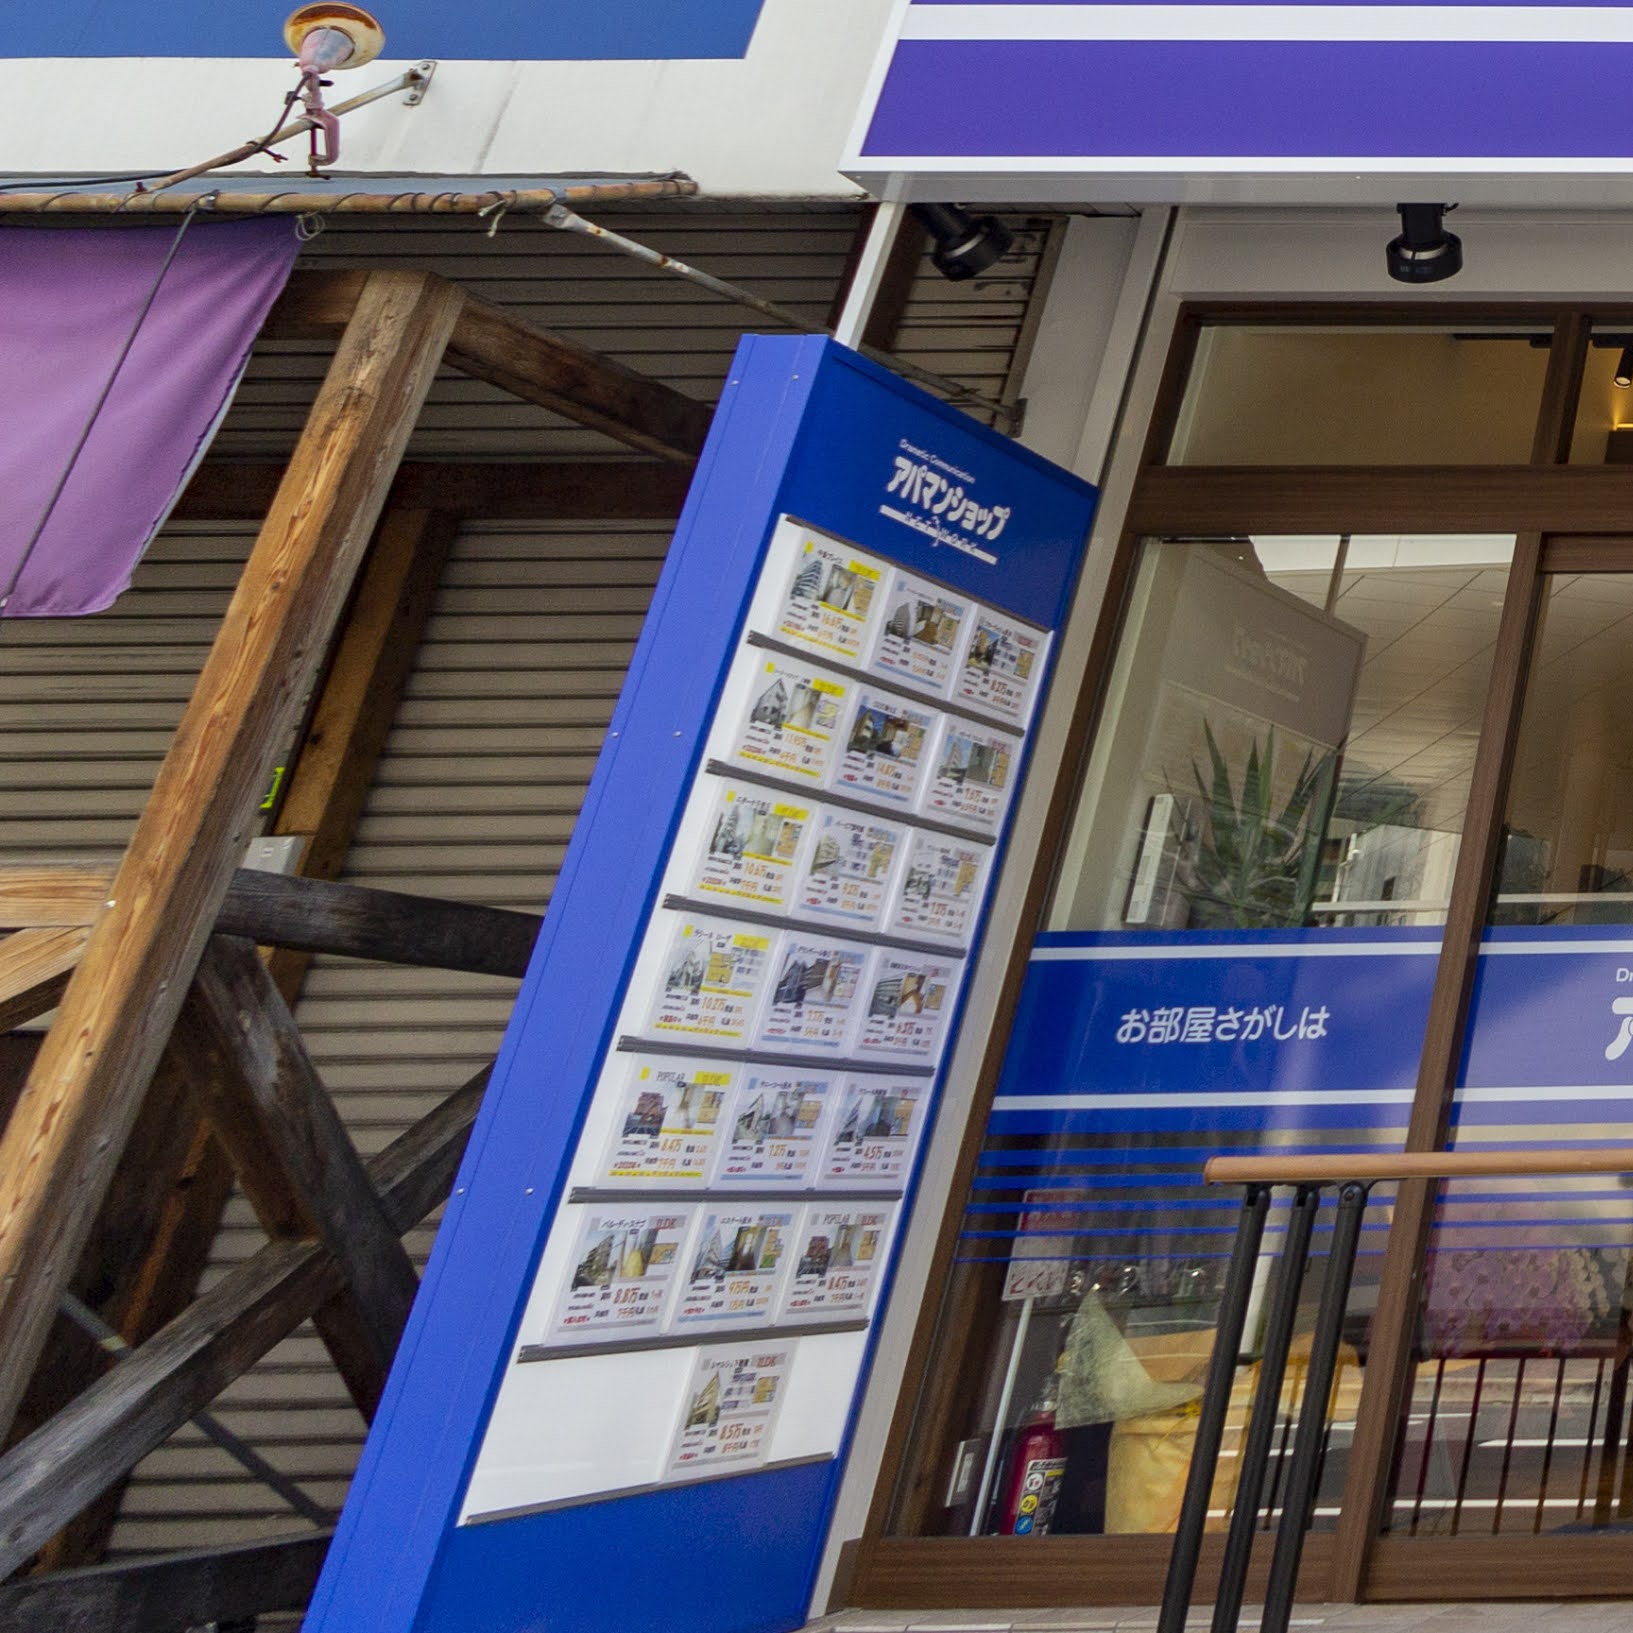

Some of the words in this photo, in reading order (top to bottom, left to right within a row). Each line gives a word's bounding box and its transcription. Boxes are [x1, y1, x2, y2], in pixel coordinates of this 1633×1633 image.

[886, 455, 1012, 541] アパマンショップ
[1116, 1005, 1330, 1044] お部屋さがしは
